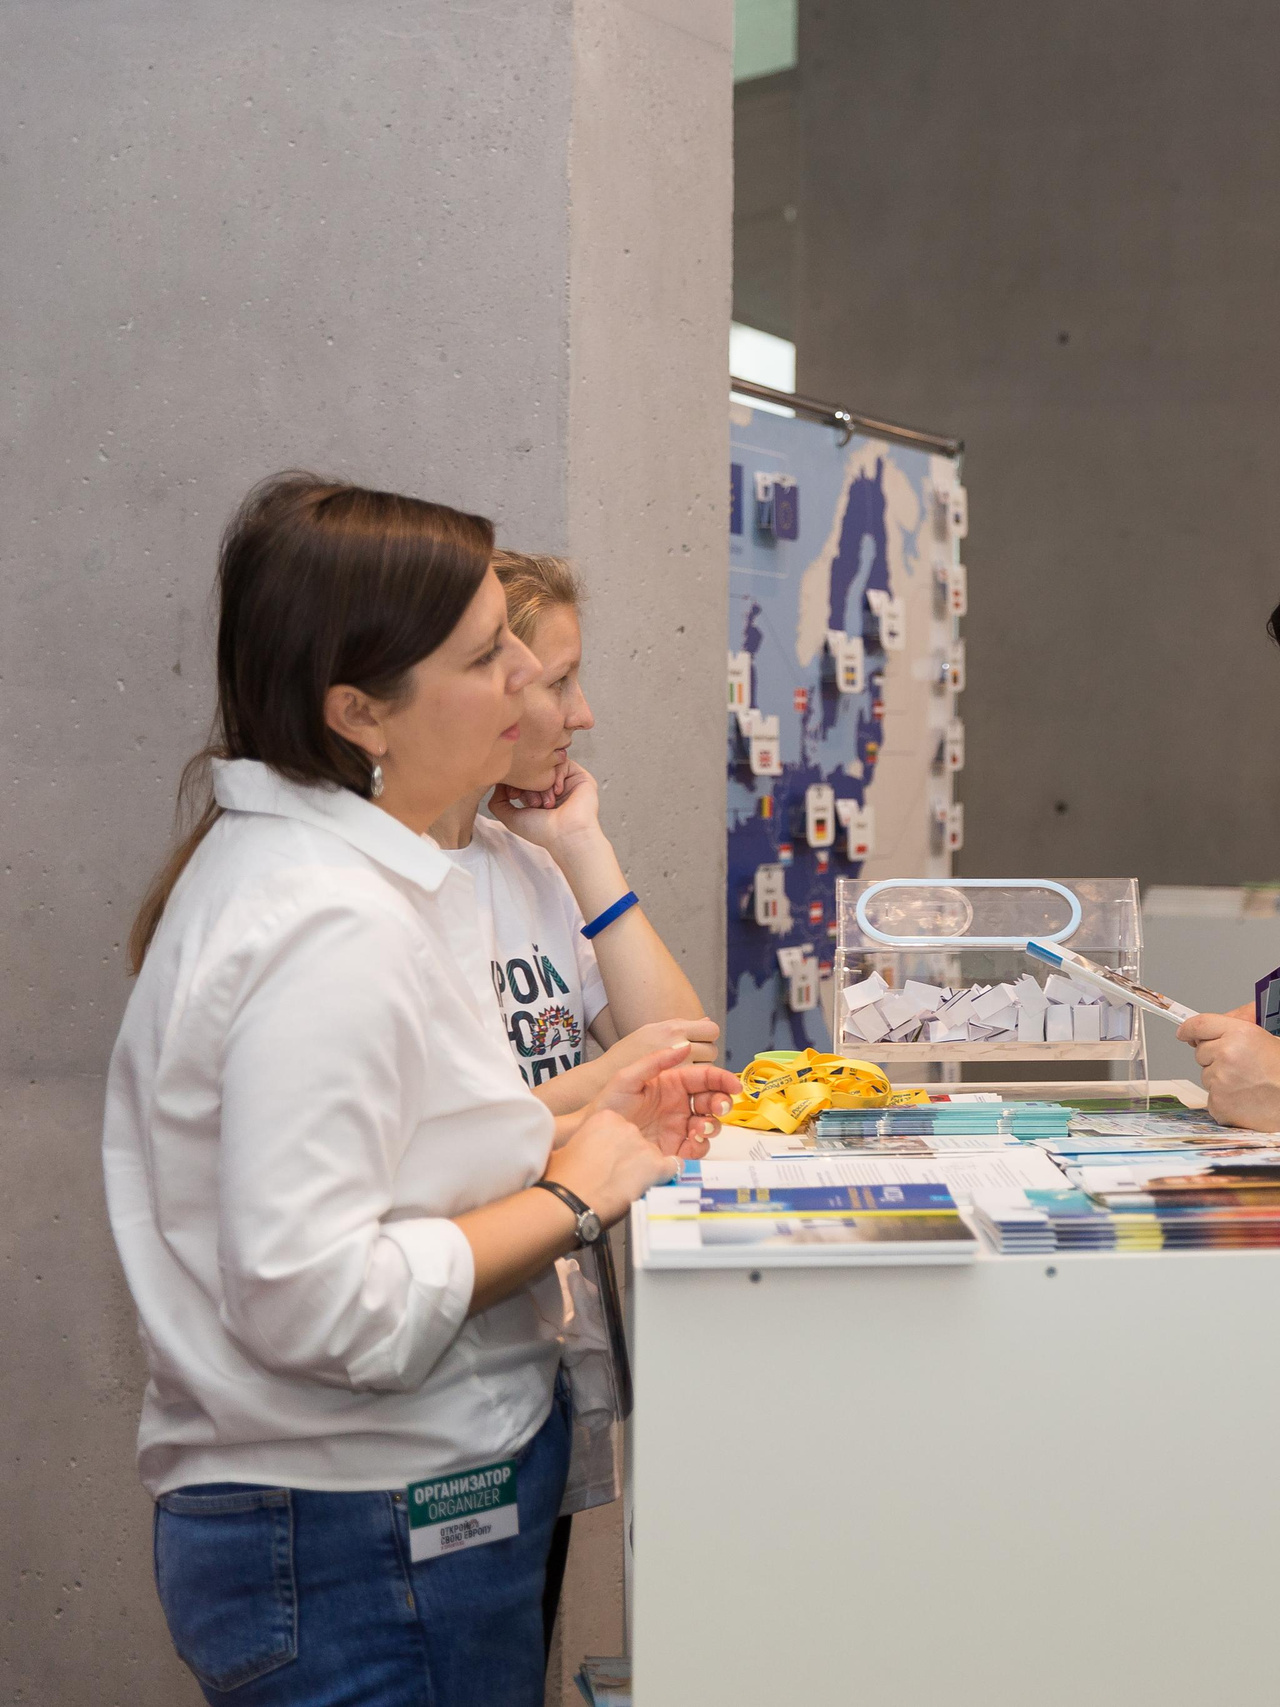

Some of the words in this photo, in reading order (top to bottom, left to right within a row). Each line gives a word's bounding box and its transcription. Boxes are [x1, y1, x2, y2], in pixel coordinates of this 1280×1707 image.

[414, 1466, 512, 1505] ОРГАНИЗАТОР
[428, 1488, 501, 1520] ORGANIZER
[440, 1520, 471, 1537] ОТКРОЙ
[440, 1533, 463, 1545] СВОЮ
[464, 1524, 492, 1539] ЕВРОПУ
